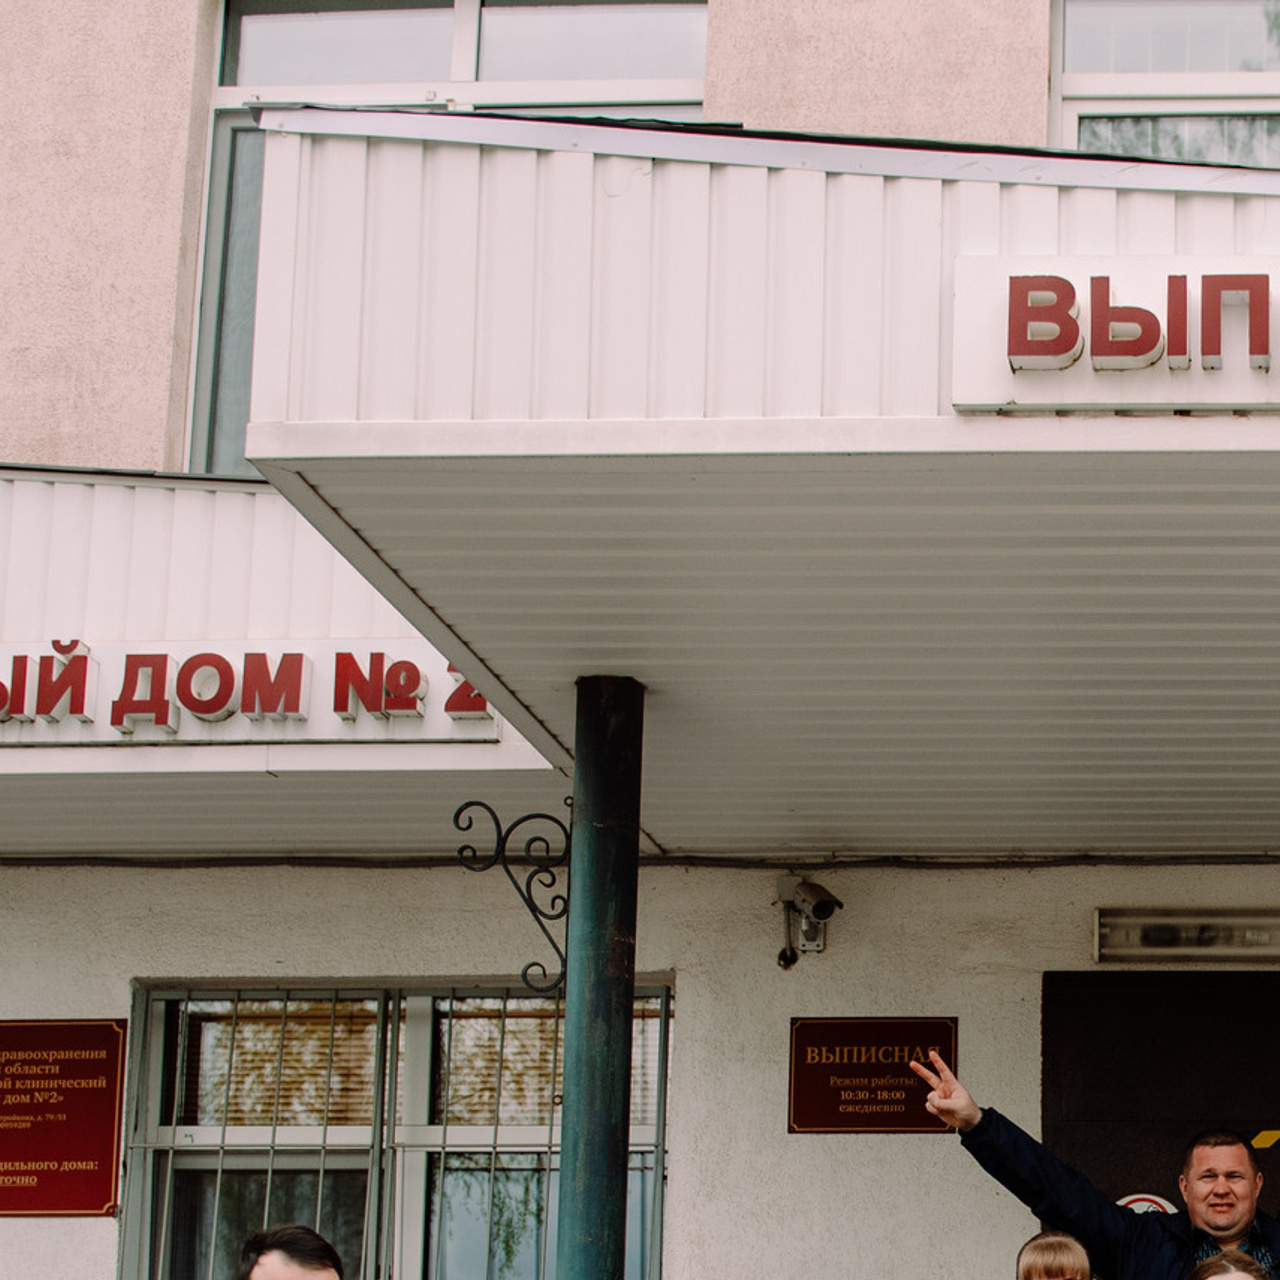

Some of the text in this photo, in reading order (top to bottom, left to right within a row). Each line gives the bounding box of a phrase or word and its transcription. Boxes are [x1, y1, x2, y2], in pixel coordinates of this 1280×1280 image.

[110, 652, 308, 730] ДОМ
[333, 651, 426, 718] №
[5, 1062, 60, 1075] области
[16, 1076, 107, 1089] клинический
[3, 1094, 31, 1105] дом
[841, 1090, 869, 1101] 10:30
[877, 1090, 906, 1101] 18:00
[839, 1104, 906, 1114] ежедневно
[60, 1161, 99, 1172] дома:
